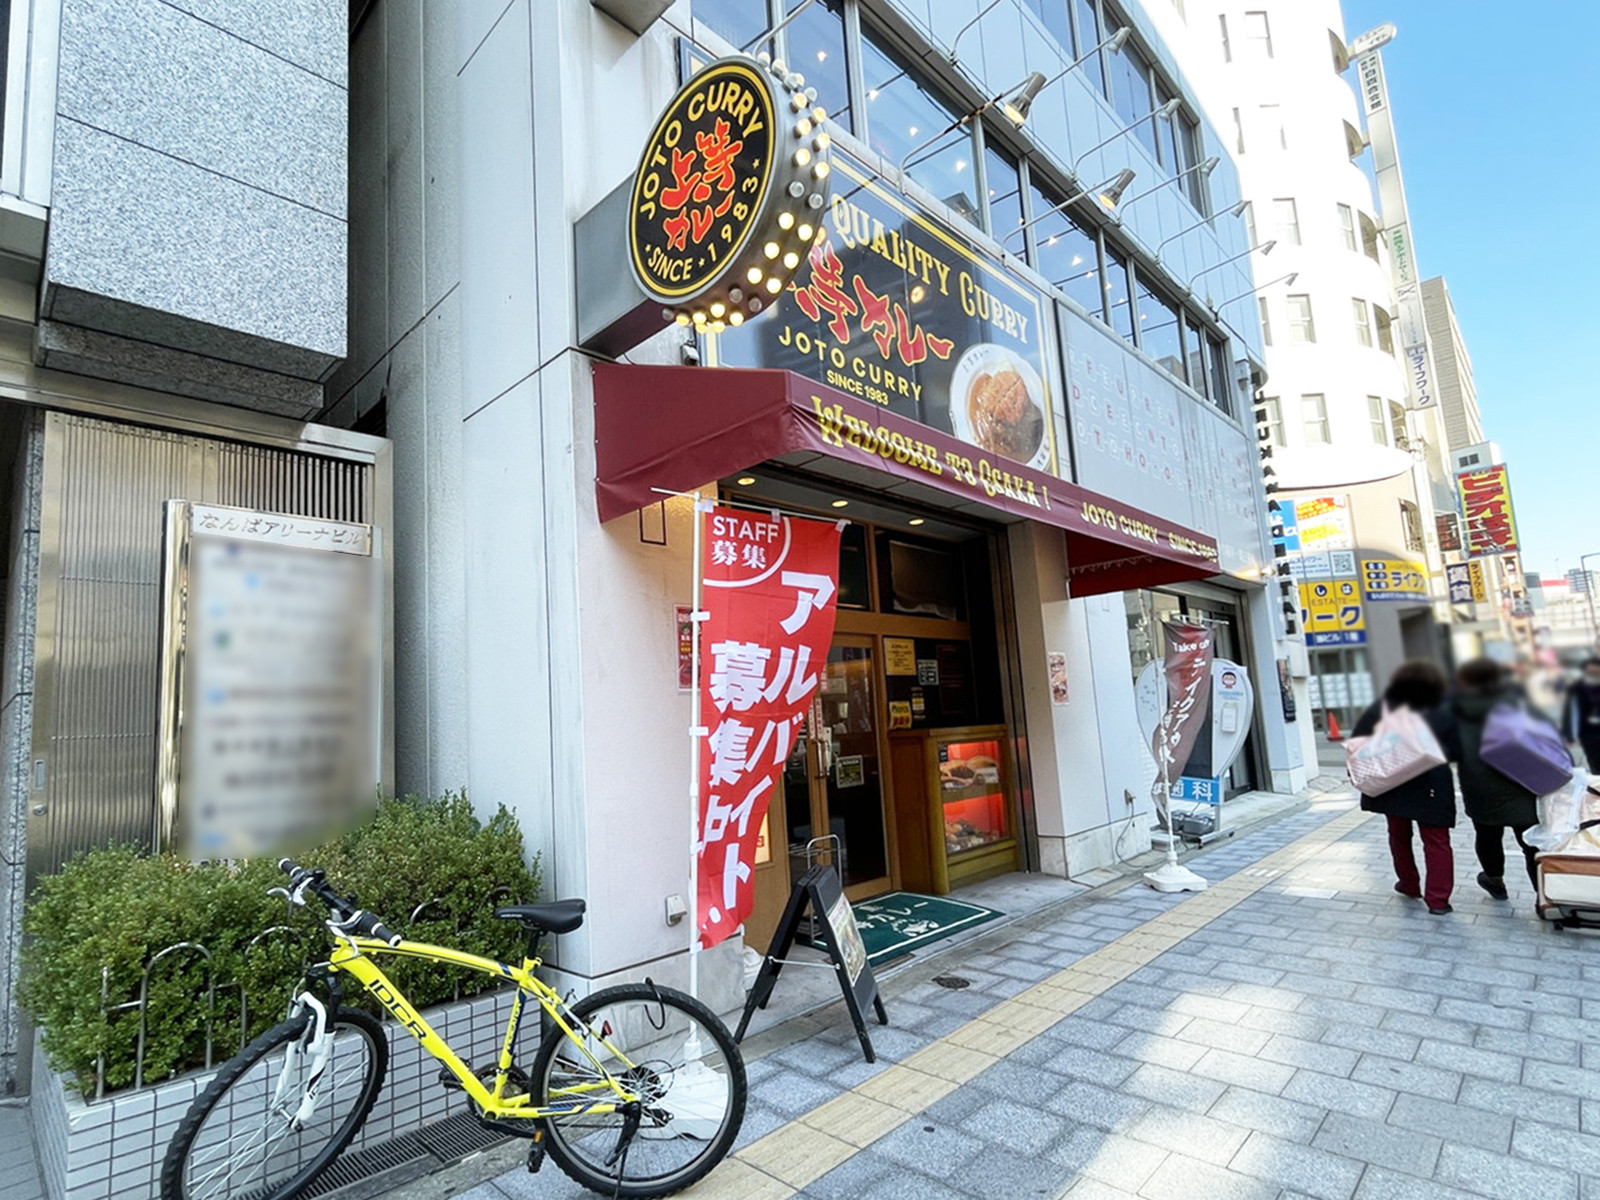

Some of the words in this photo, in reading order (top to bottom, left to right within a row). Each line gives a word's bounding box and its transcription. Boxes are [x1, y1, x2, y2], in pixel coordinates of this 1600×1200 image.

[640, 119, 683, 220] JOTO
[687, 81, 764, 140] CURRY
[647, 247, 693, 282] SINCE
[707, 176, 759, 262] 1983
[830, 192, 952, 297] QUALITY
[959, 271, 1028, 344] CURRY
[778, 325, 846, 369] JOTO
[851, 356, 924, 402] CURRY
[826, 370, 864, 396] SINCE
[864, 384, 890, 406] 1983
[810, 395, 944, 476] WELCOME
[945, 451, 978, 487] TO
[978, 459, 1043, 510] OSAKA
[199, 511, 365, 546] なんばアリーナビル
[713, 515, 779, 543] STAFF
[1080, 501, 1117, 531] JOTO
[1118, 515, 1159, 544] CURRY
[711, 539, 766, 569] 募集
[1172, 640, 1197, 652] Take
[723, 570, 836, 910] アルバイト
